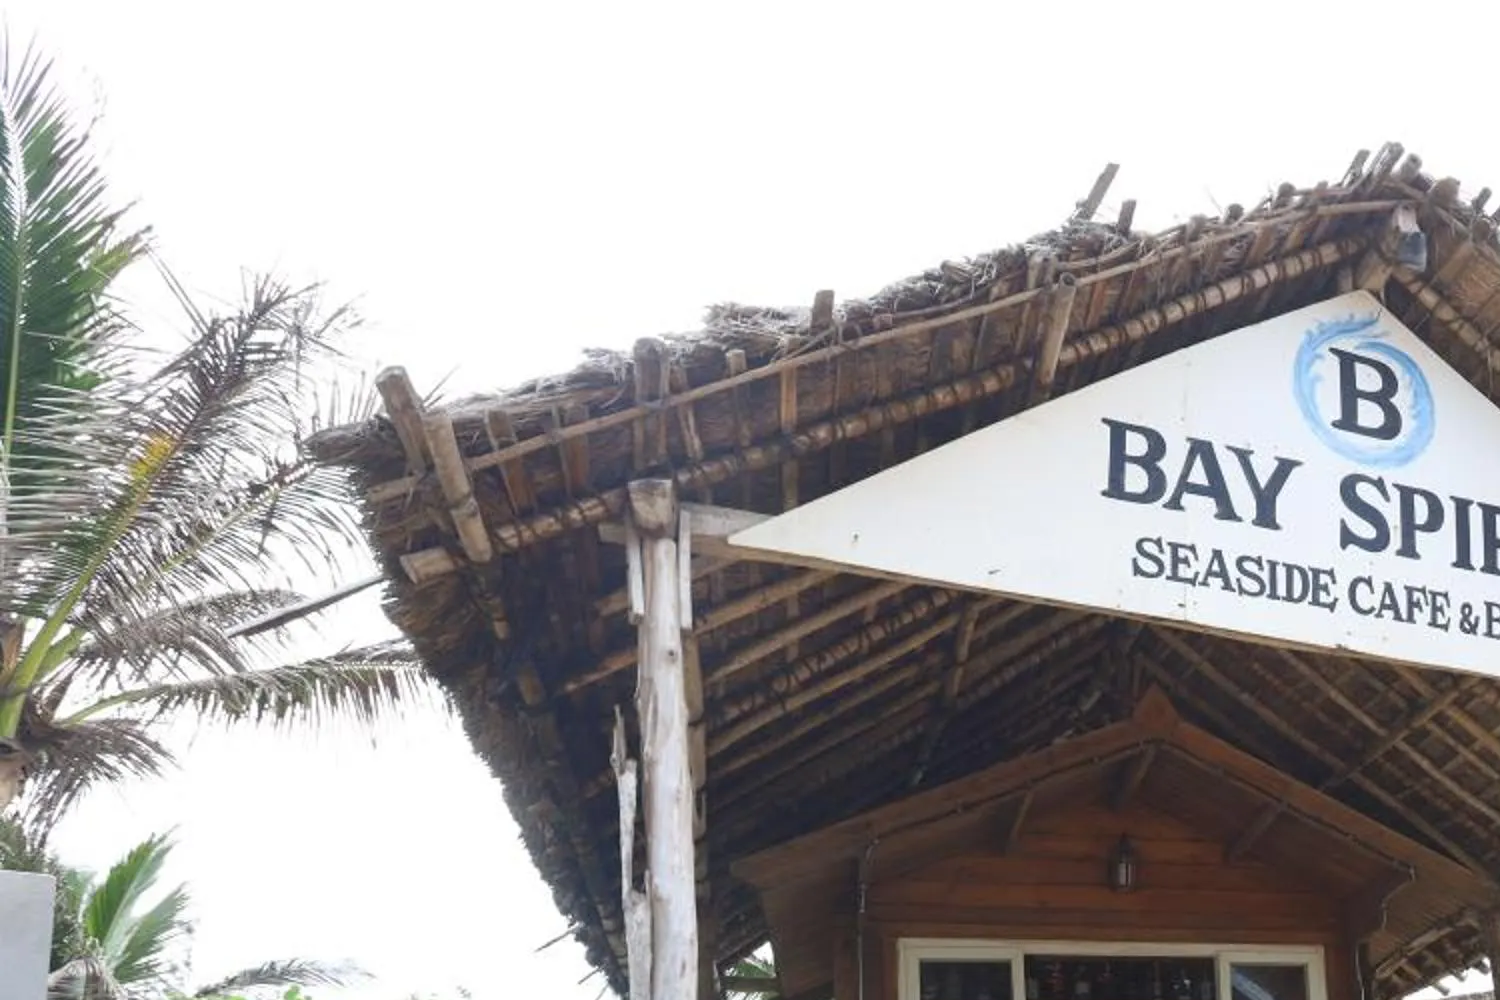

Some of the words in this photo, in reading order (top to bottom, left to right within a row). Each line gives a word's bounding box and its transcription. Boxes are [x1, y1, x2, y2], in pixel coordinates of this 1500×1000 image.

[1328, 347, 1403, 441] B
[1100, 417, 1302, 531] BAY
[1132, 536, 1339, 613] SEASIDE
[1347, 575, 1451, 633] CAFE
